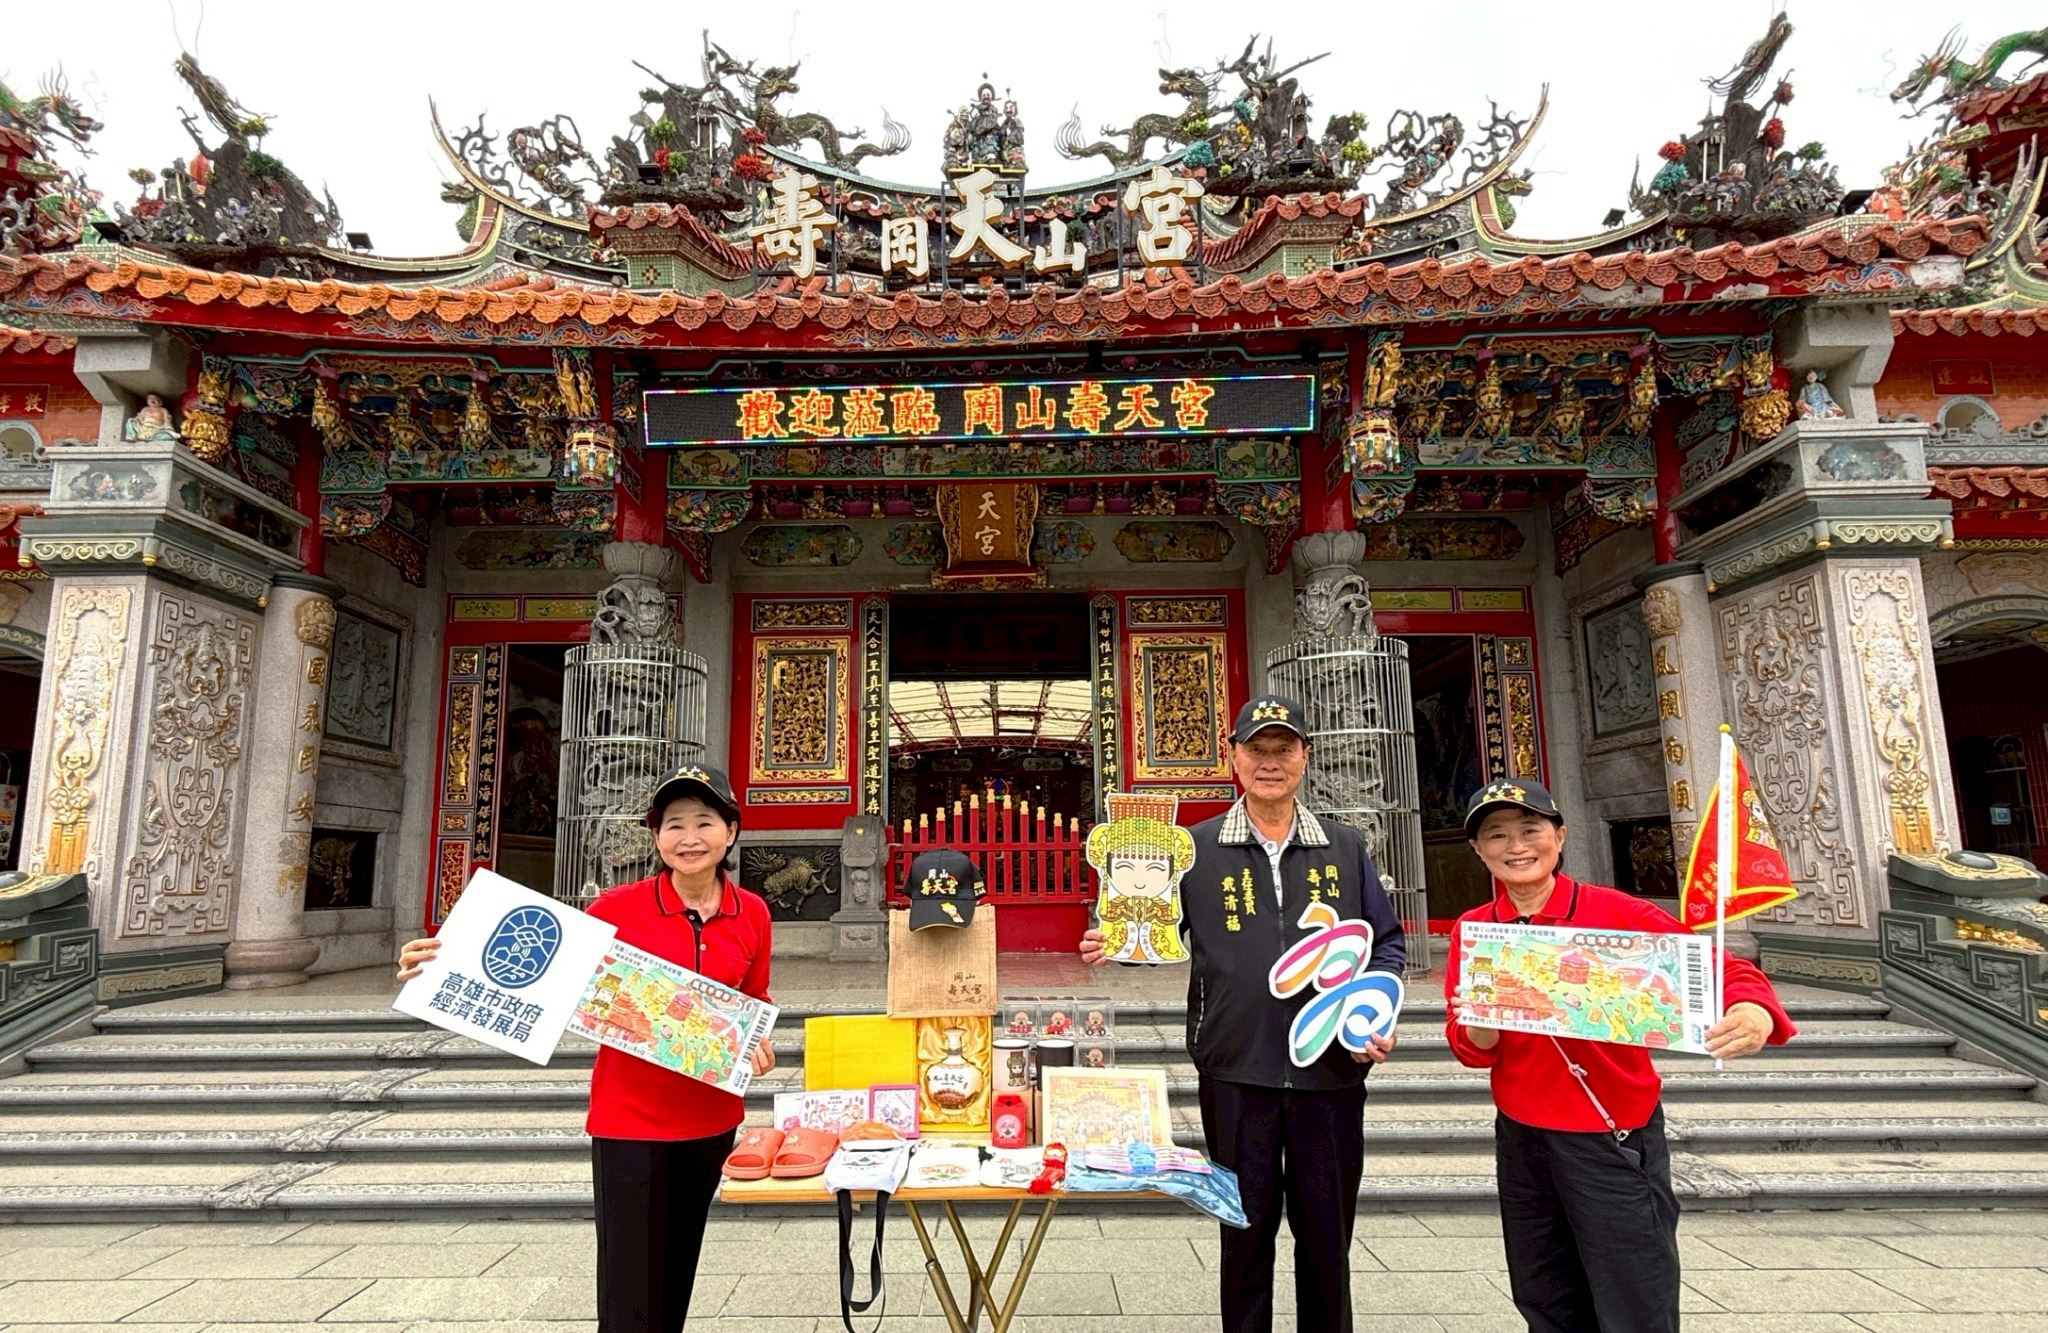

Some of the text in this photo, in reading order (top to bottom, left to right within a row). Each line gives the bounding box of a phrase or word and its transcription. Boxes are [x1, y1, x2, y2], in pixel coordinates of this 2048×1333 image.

[736, 379, 1216, 440] 歡迎蒞臨 岡山壽天宮
[288, 655, 326, 825] 國泰民安
[1654, 645, 1694, 813] 風調雨順
[428, 991, 533, 1044] 經濟發展局
[440, 971, 545, 1025] 高雄市政府
